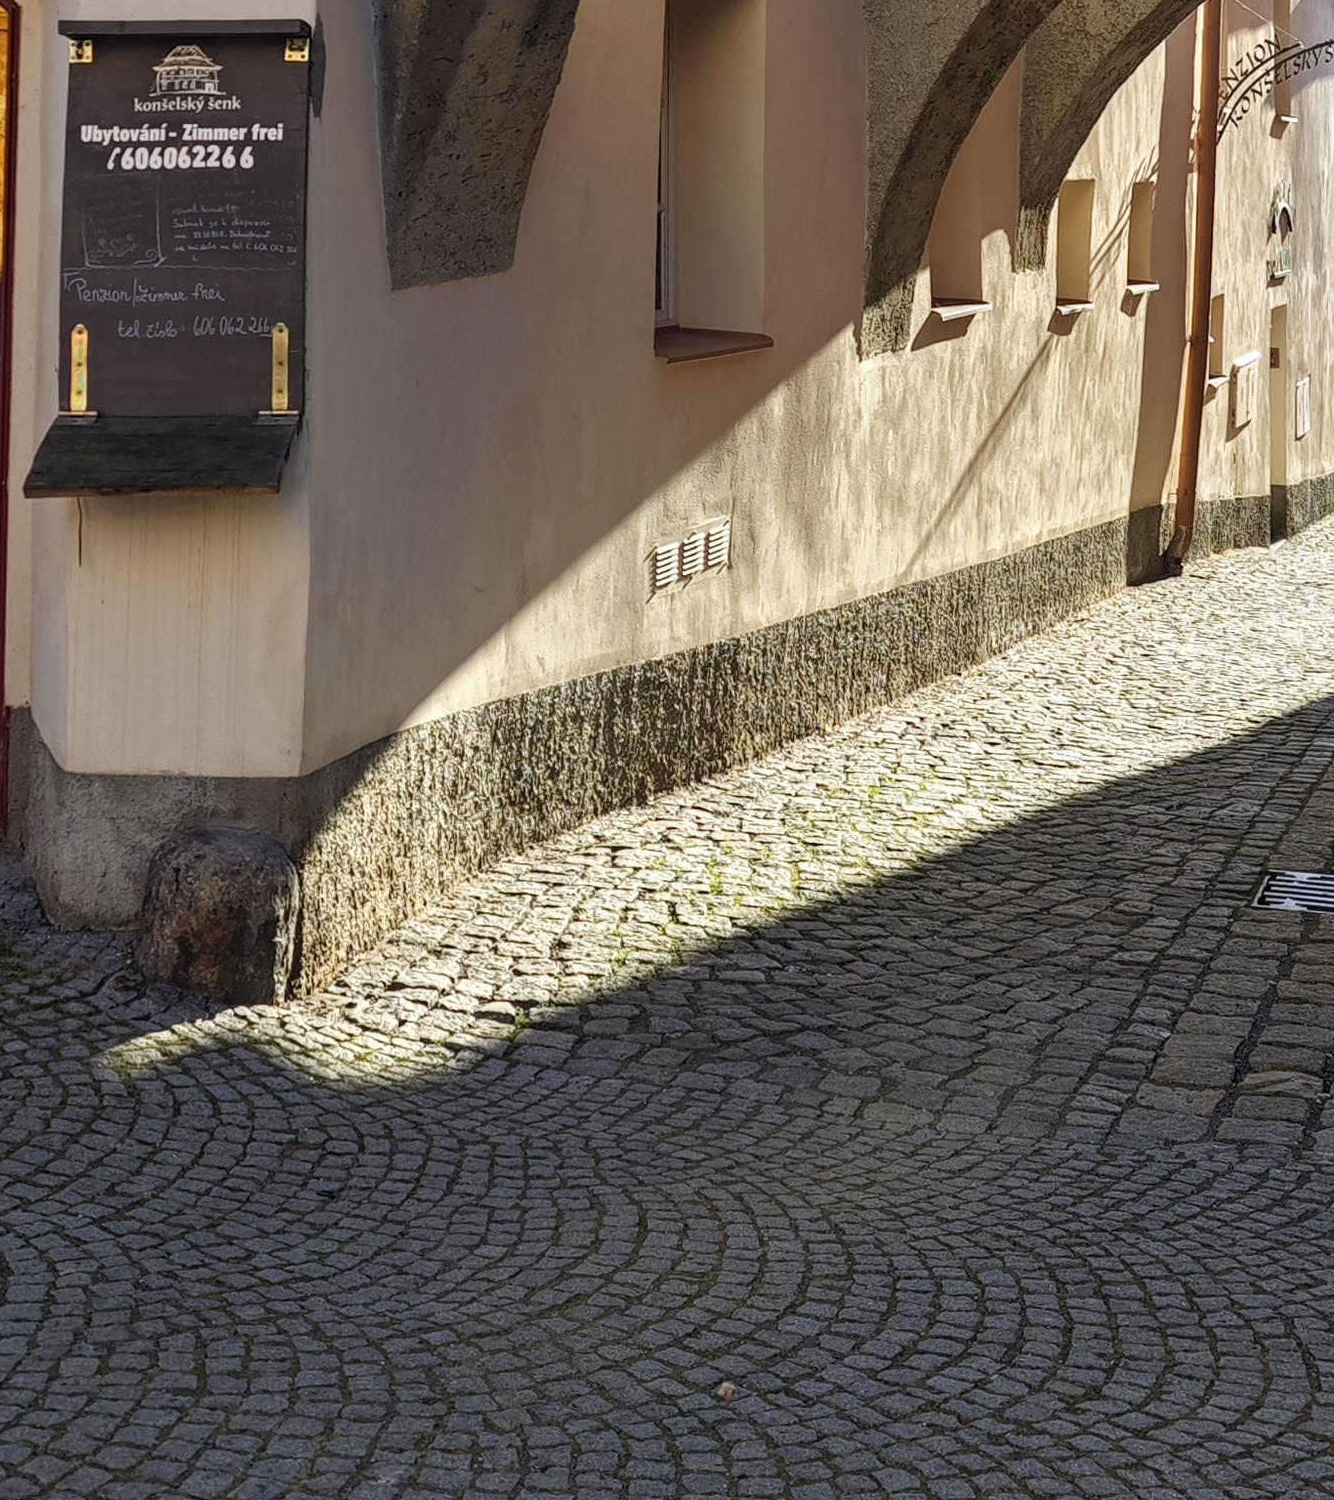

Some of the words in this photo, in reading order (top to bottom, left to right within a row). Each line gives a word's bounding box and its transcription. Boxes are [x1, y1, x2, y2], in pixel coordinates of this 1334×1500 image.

[1219, 33, 1281, 100] ENZION
[134, 97, 205, 113] konšelský
[207, 96, 241, 111] šenk
[80, 123, 168, 146] Ubytování
[182, 123, 247, 141] Zimmer
[251, 123, 284, 141] frei
[193, 316, 216, 336] 606
[219, 316, 247, 335] 062
